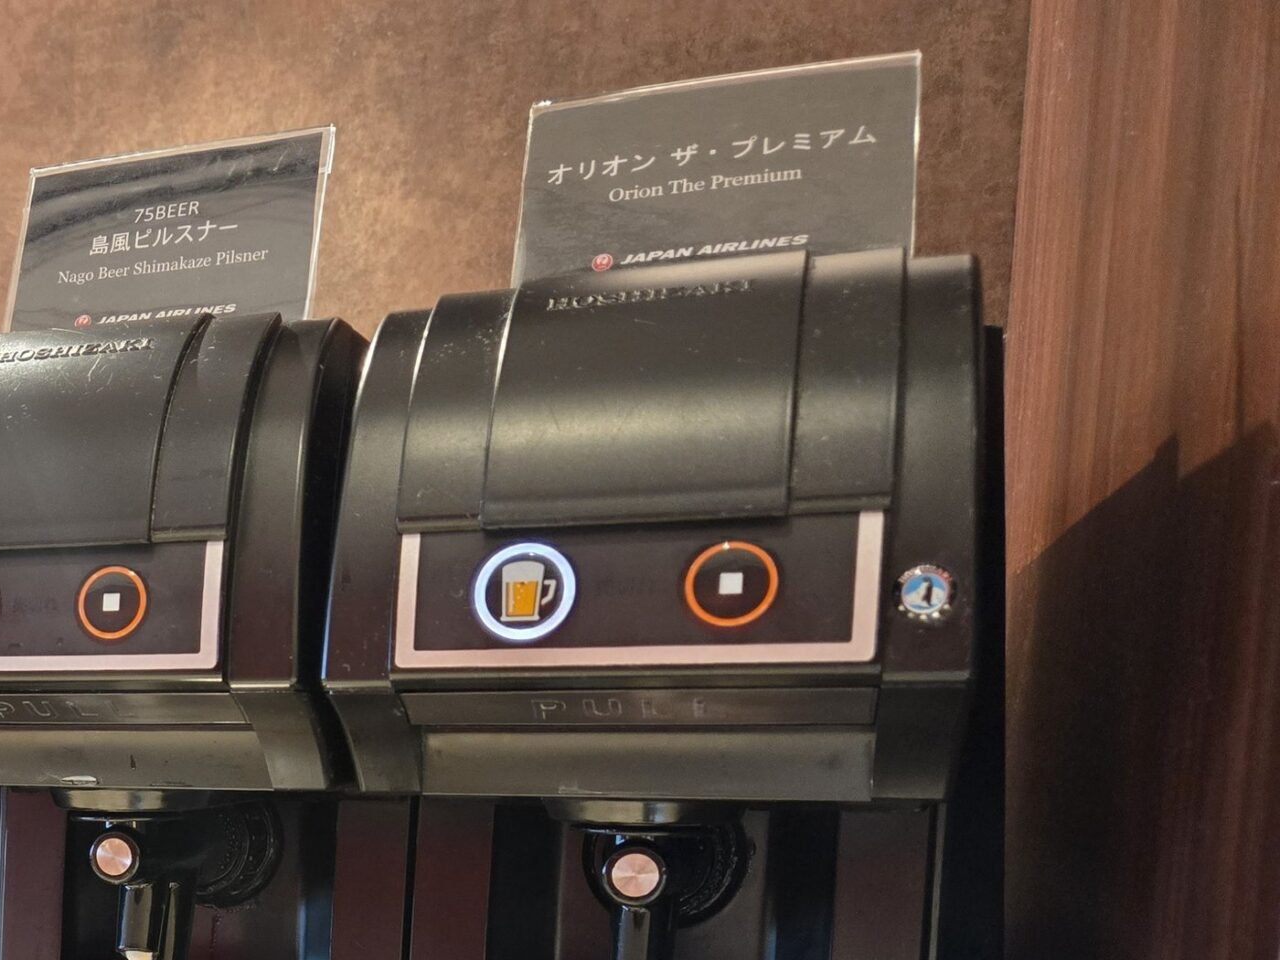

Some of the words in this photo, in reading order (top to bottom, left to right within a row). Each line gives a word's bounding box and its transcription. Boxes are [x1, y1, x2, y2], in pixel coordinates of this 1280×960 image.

[547, 153, 656, 185] オリオン
[671, 125, 877, 167] ザ・プレミアム
[609, 183, 663, 202] Orion
[668, 177, 705, 195] The
[710, 166, 802, 190] Premium
[134, 201, 200, 223] 75BEER
[89, 220, 239, 256] 島風ピルスナー
[621, 247, 695, 265] JAPAN
[697, 234, 809, 255] AIRLINES
[57, 270, 94, 285] Nago
[98, 264, 130, 279] Beer
[133, 255, 212, 275] Shimakaze
[216, 248, 269, 266] Pilsner
[96, 311, 152, 325] JAPAN
[155, 303, 238, 319] AIRLINES
